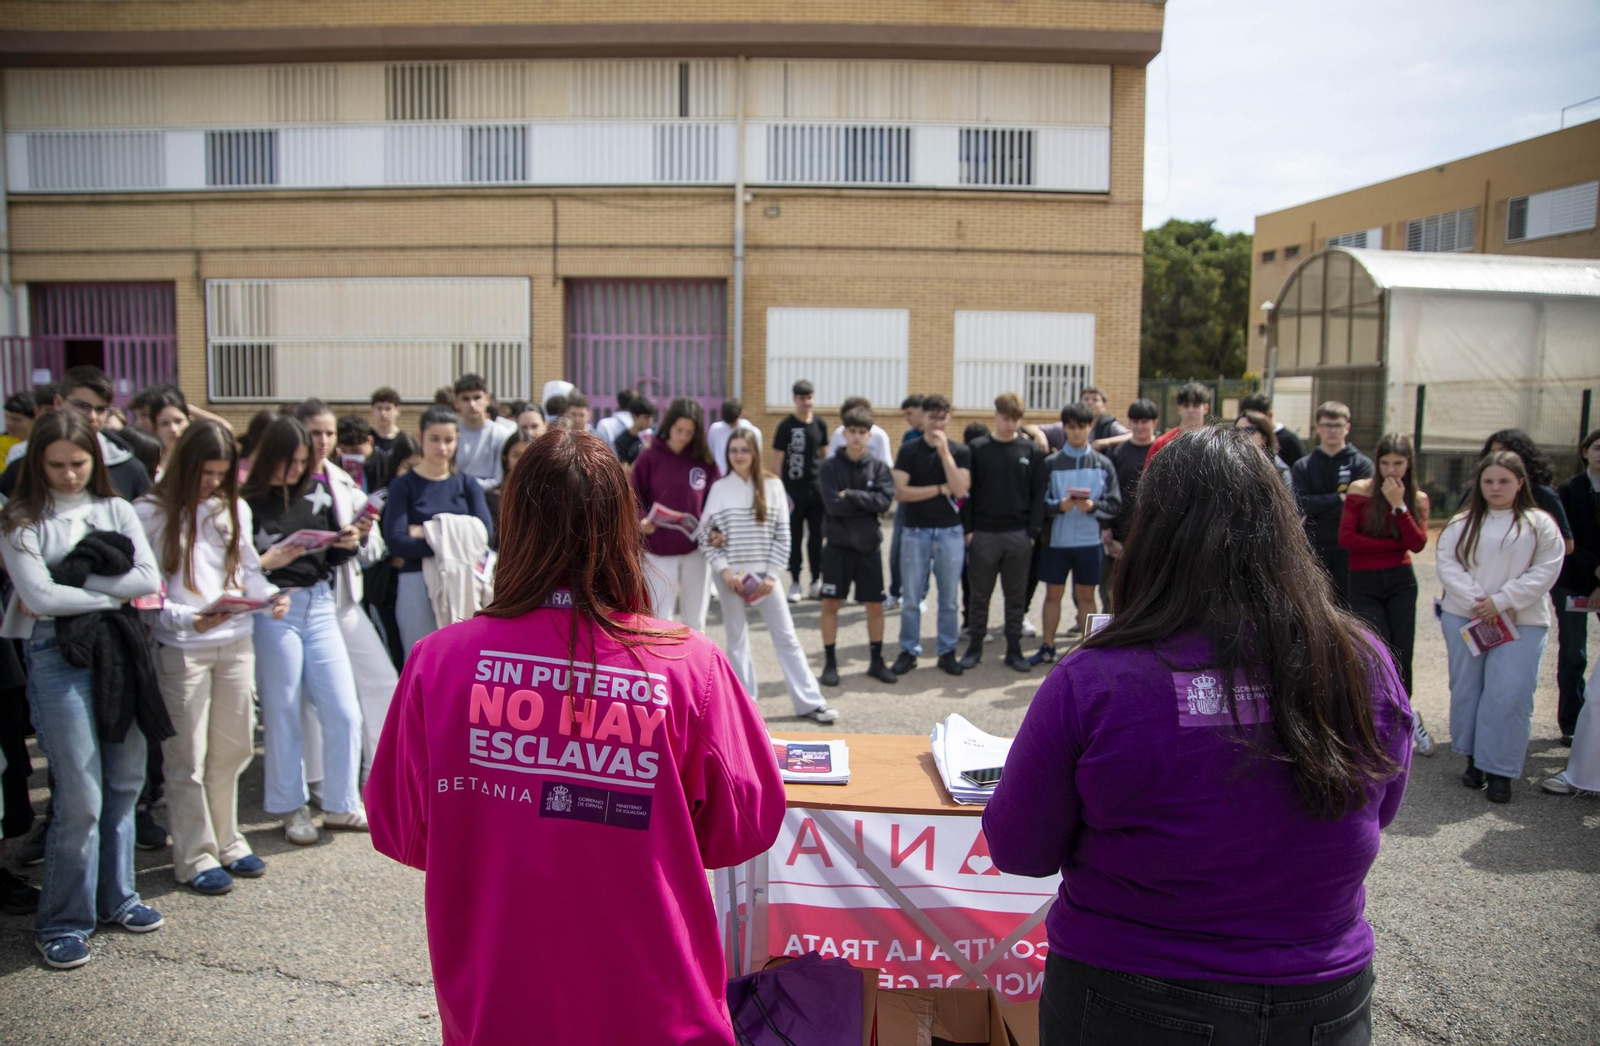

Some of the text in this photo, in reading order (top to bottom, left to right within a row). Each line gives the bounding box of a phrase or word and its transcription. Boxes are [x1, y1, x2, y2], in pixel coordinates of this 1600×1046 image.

[788, 427, 806, 480] KENZO
[474, 659, 669, 706] SIN PUTEROS
[469, 683, 666, 747] NO HAY
[469, 728, 660, 780] ESCLAVAS
[437, 776, 533, 804] BETANIA
[577, 796, 604, 805] GOBIERNO
[616, 803, 642, 811] MINISTERIO
[623, 808, 648, 816] IGUALDAD
